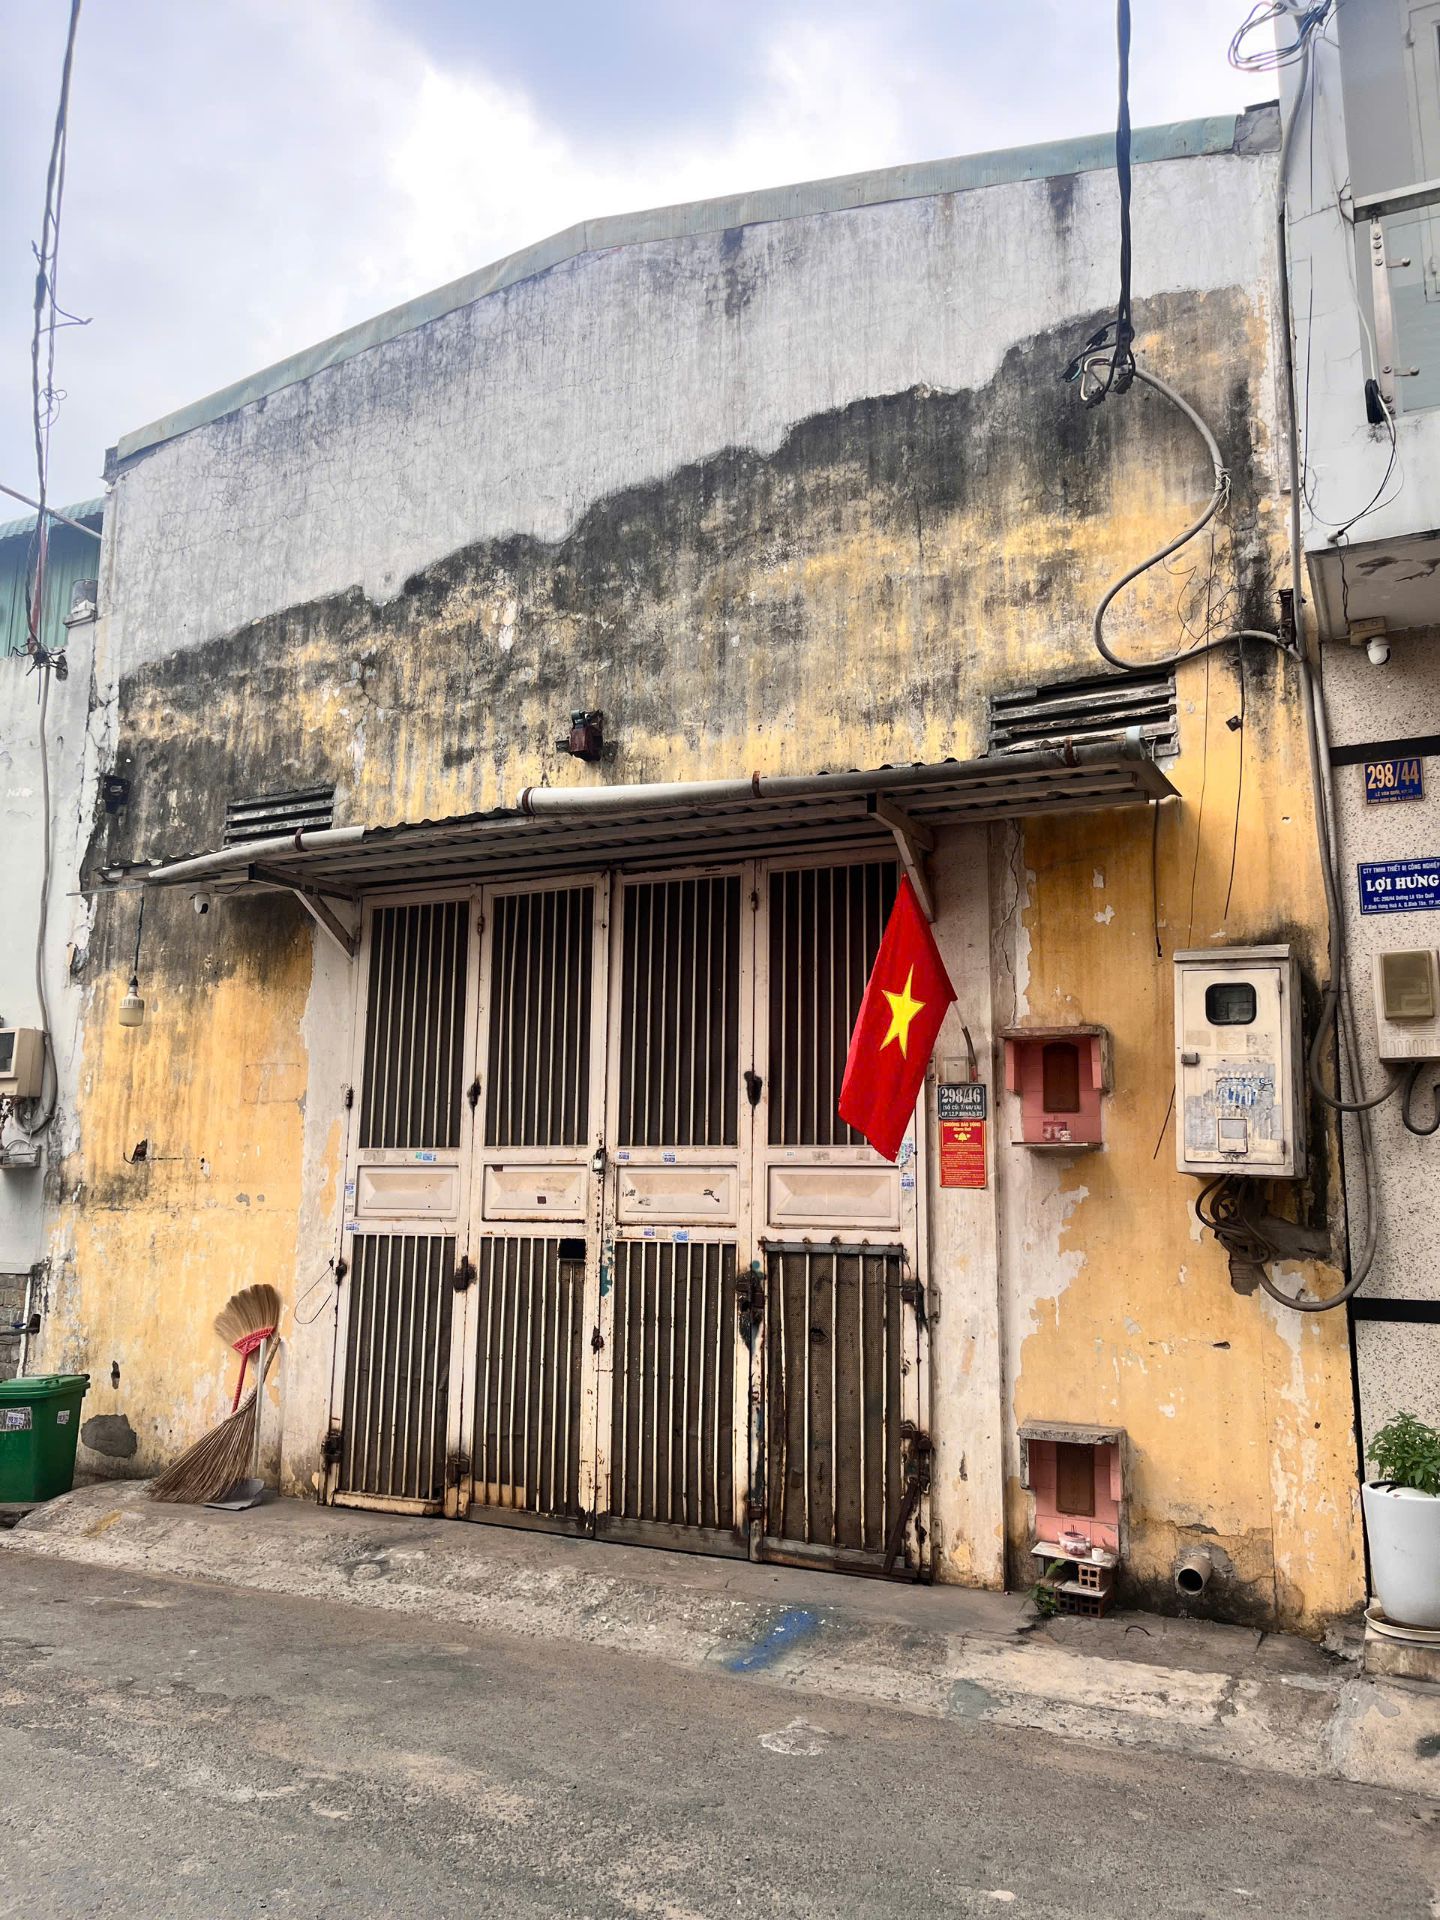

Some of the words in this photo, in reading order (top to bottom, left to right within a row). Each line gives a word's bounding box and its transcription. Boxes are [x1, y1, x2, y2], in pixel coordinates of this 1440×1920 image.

[1367, 760, 1419, 789] 298/44
[1366, 876, 1392, 893] LỢI
[1395, 873, 1439, 889] HƯNG
[941, 1088, 981, 1103] 298/46
